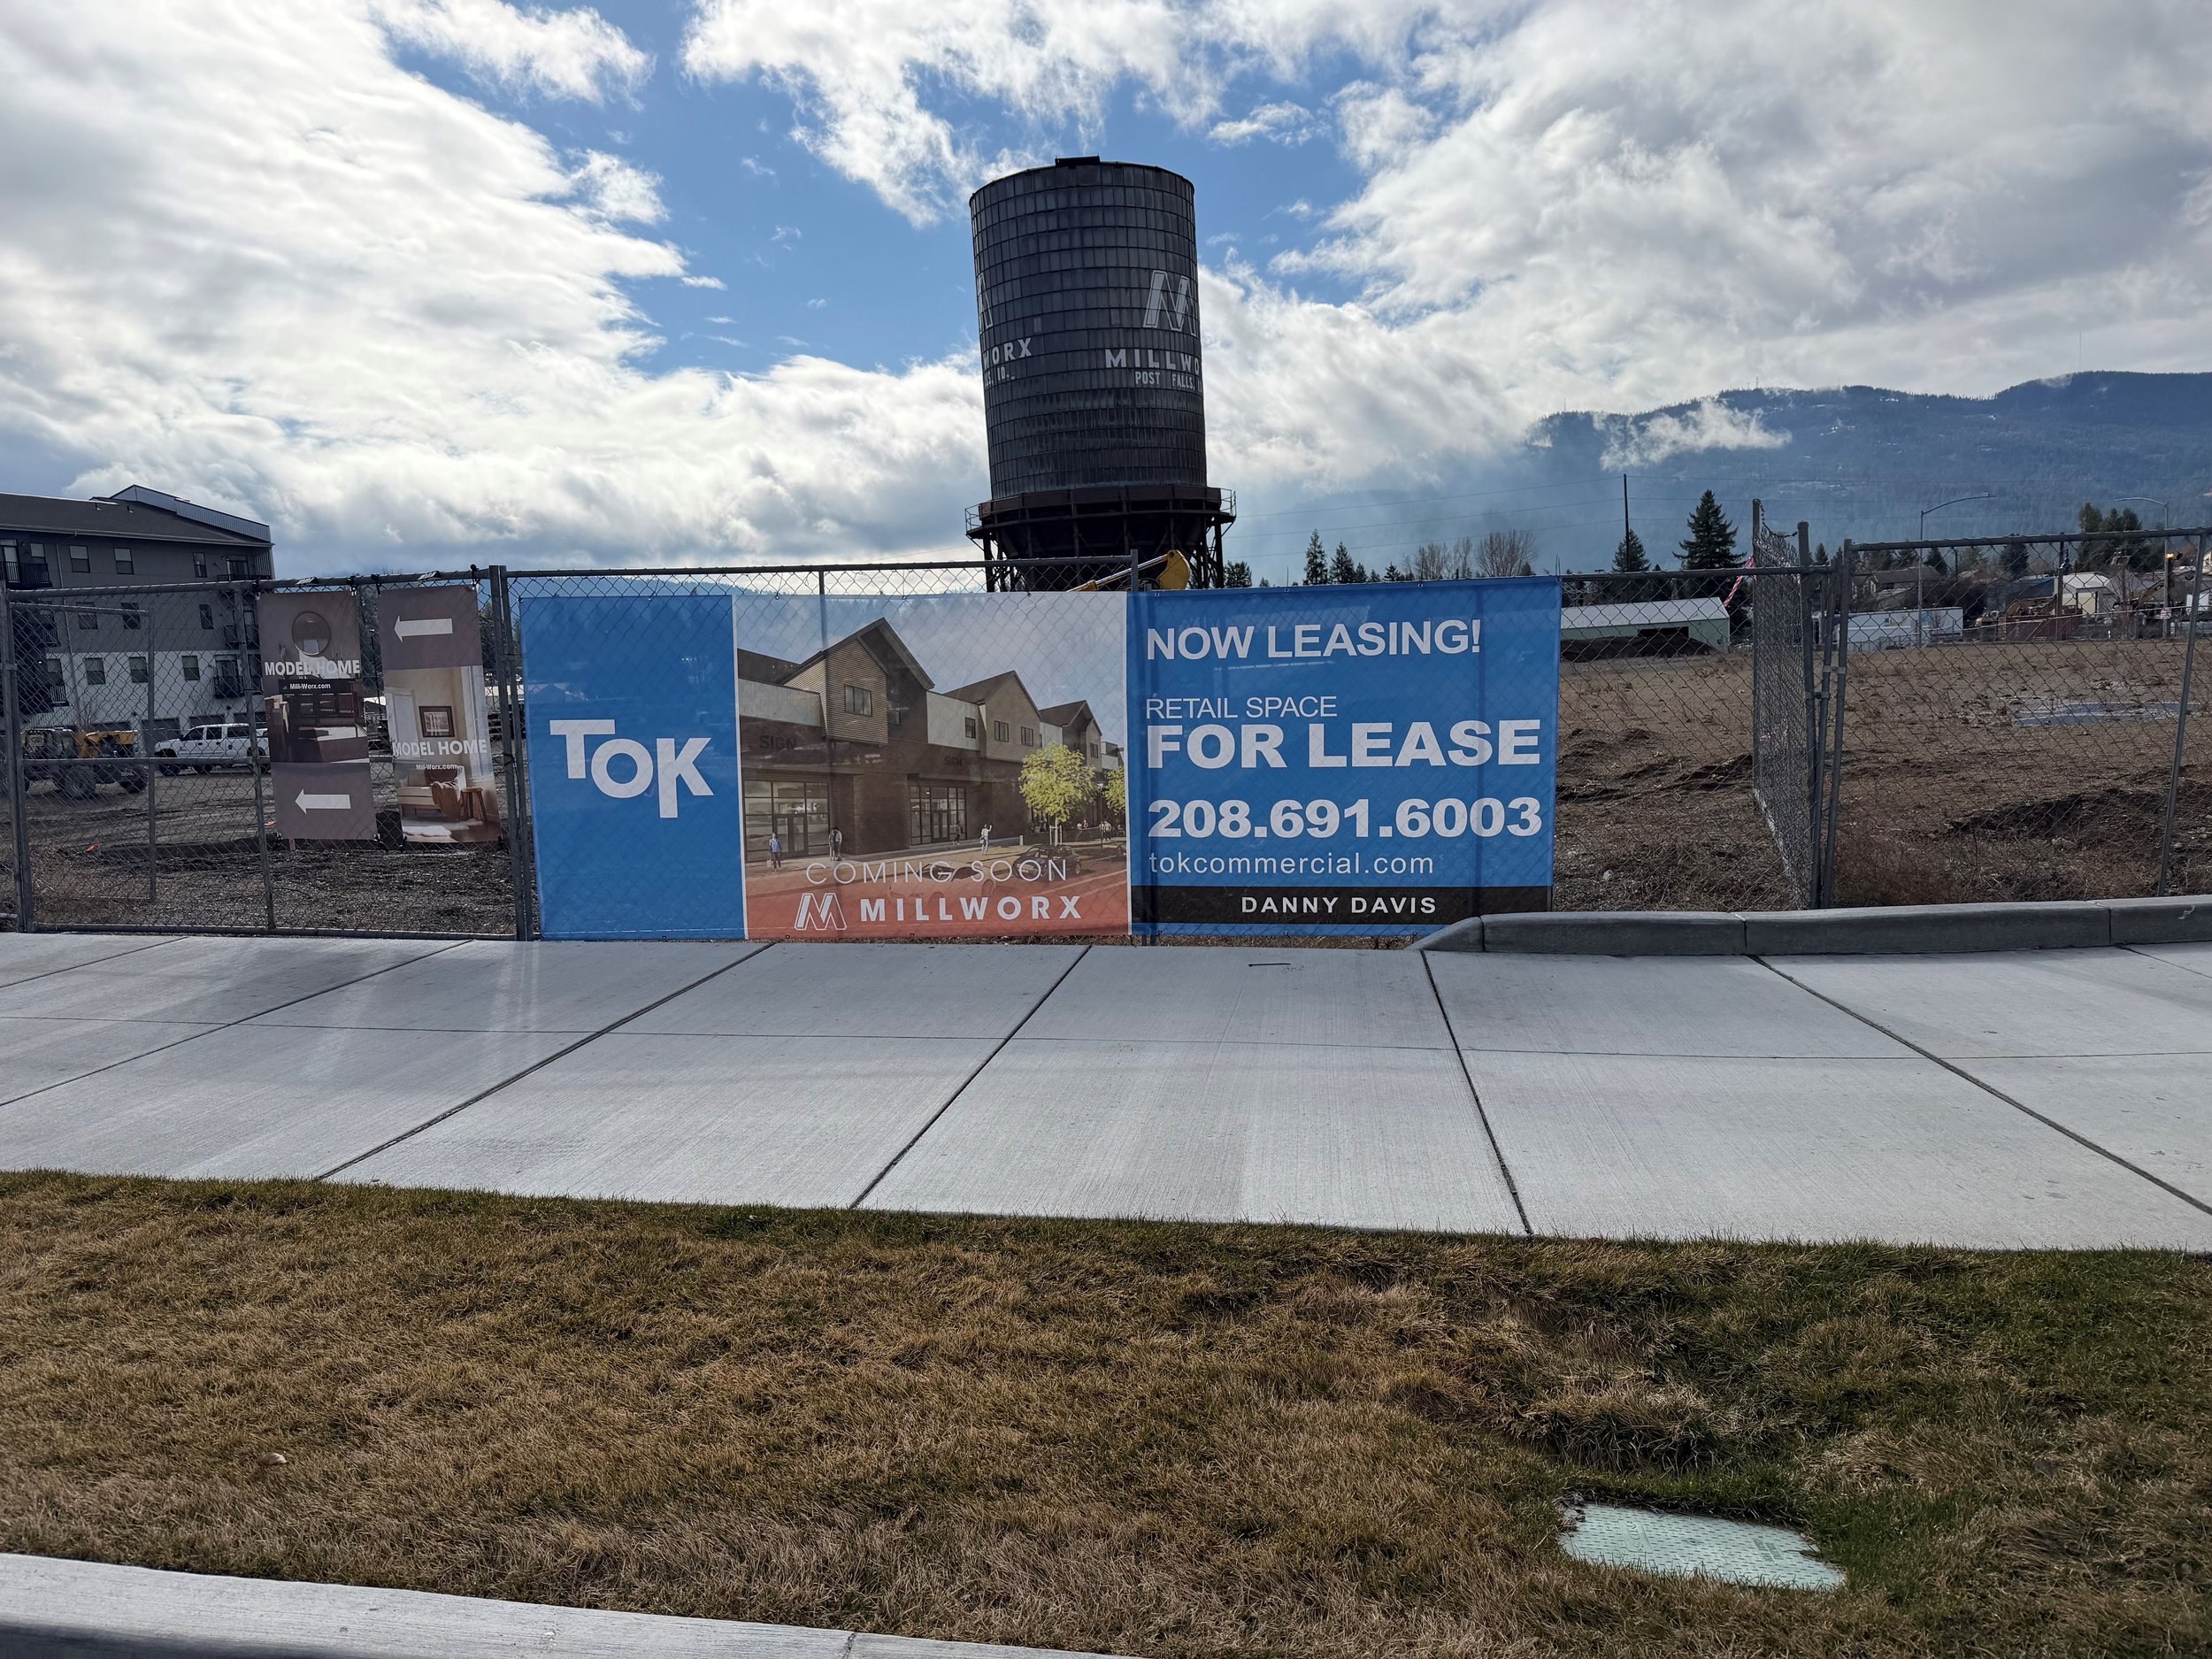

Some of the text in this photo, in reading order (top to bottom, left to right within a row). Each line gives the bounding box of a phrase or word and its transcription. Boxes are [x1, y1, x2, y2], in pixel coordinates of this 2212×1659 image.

[1135, 372, 1161, 385] POST
[1147, 619, 1481, 661] NOW LEASING!
[265, 659, 361, 676] MODEL HOME
[1146, 695, 1337, 719] RETAIL SPACE
[392, 739, 488, 757] MODEL HOME
[1147, 718, 1540, 769] FOR LEASE
[549, 718, 714, 818] TOK
[1148, 797, 1542, 838] 208.691.6003
[806, 859, 1067, 885] COMING SOON
[1149, 851, 1434, 874] tokcommercial.com
[860, 895, 1081, 922] MILLWORX
[1241, 896, 1436, 914] DANNY DAVIS
